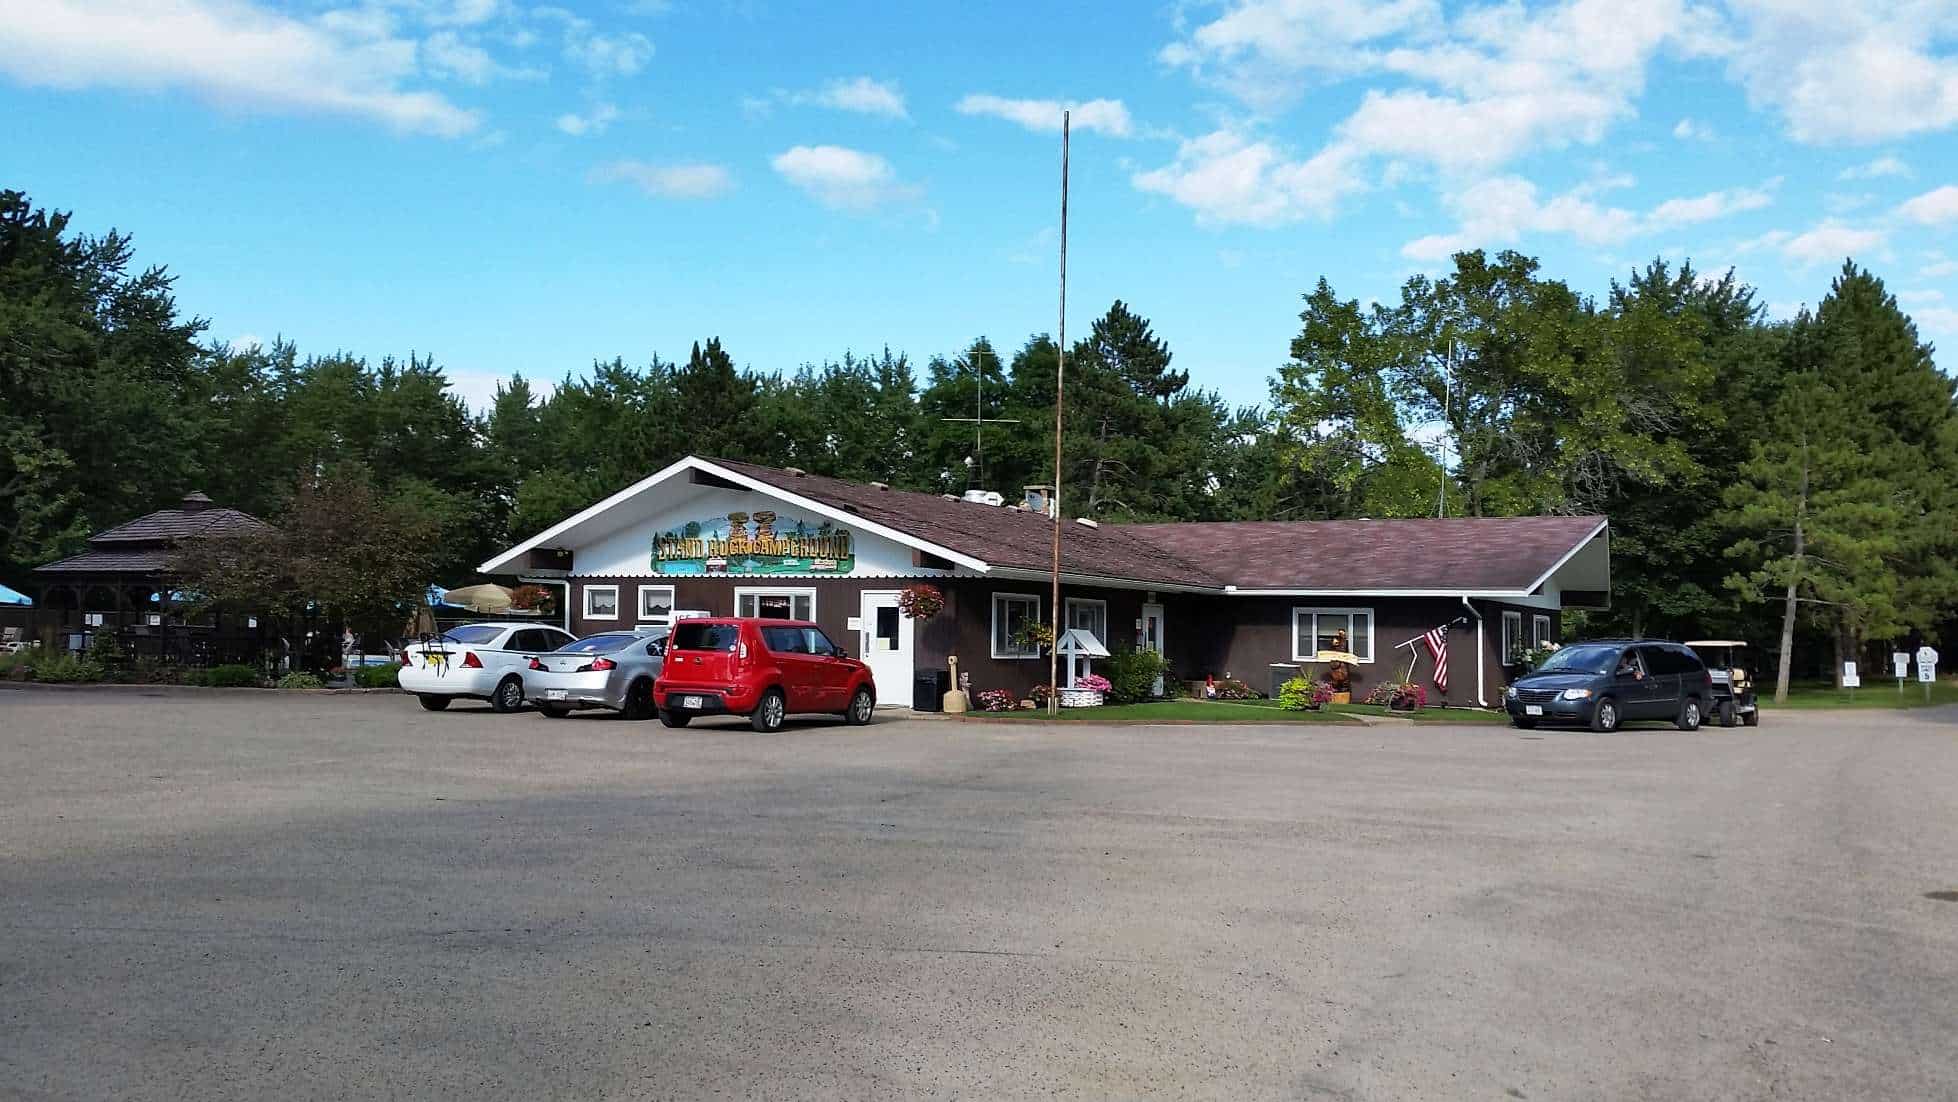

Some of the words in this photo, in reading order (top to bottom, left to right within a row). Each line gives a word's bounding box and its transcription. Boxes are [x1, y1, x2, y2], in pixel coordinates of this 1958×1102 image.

[657, 537, 705, 560] STAND
[708, 537, 748, 557] ROCK
[752, 533, 849, 559] CAMPGROUND
